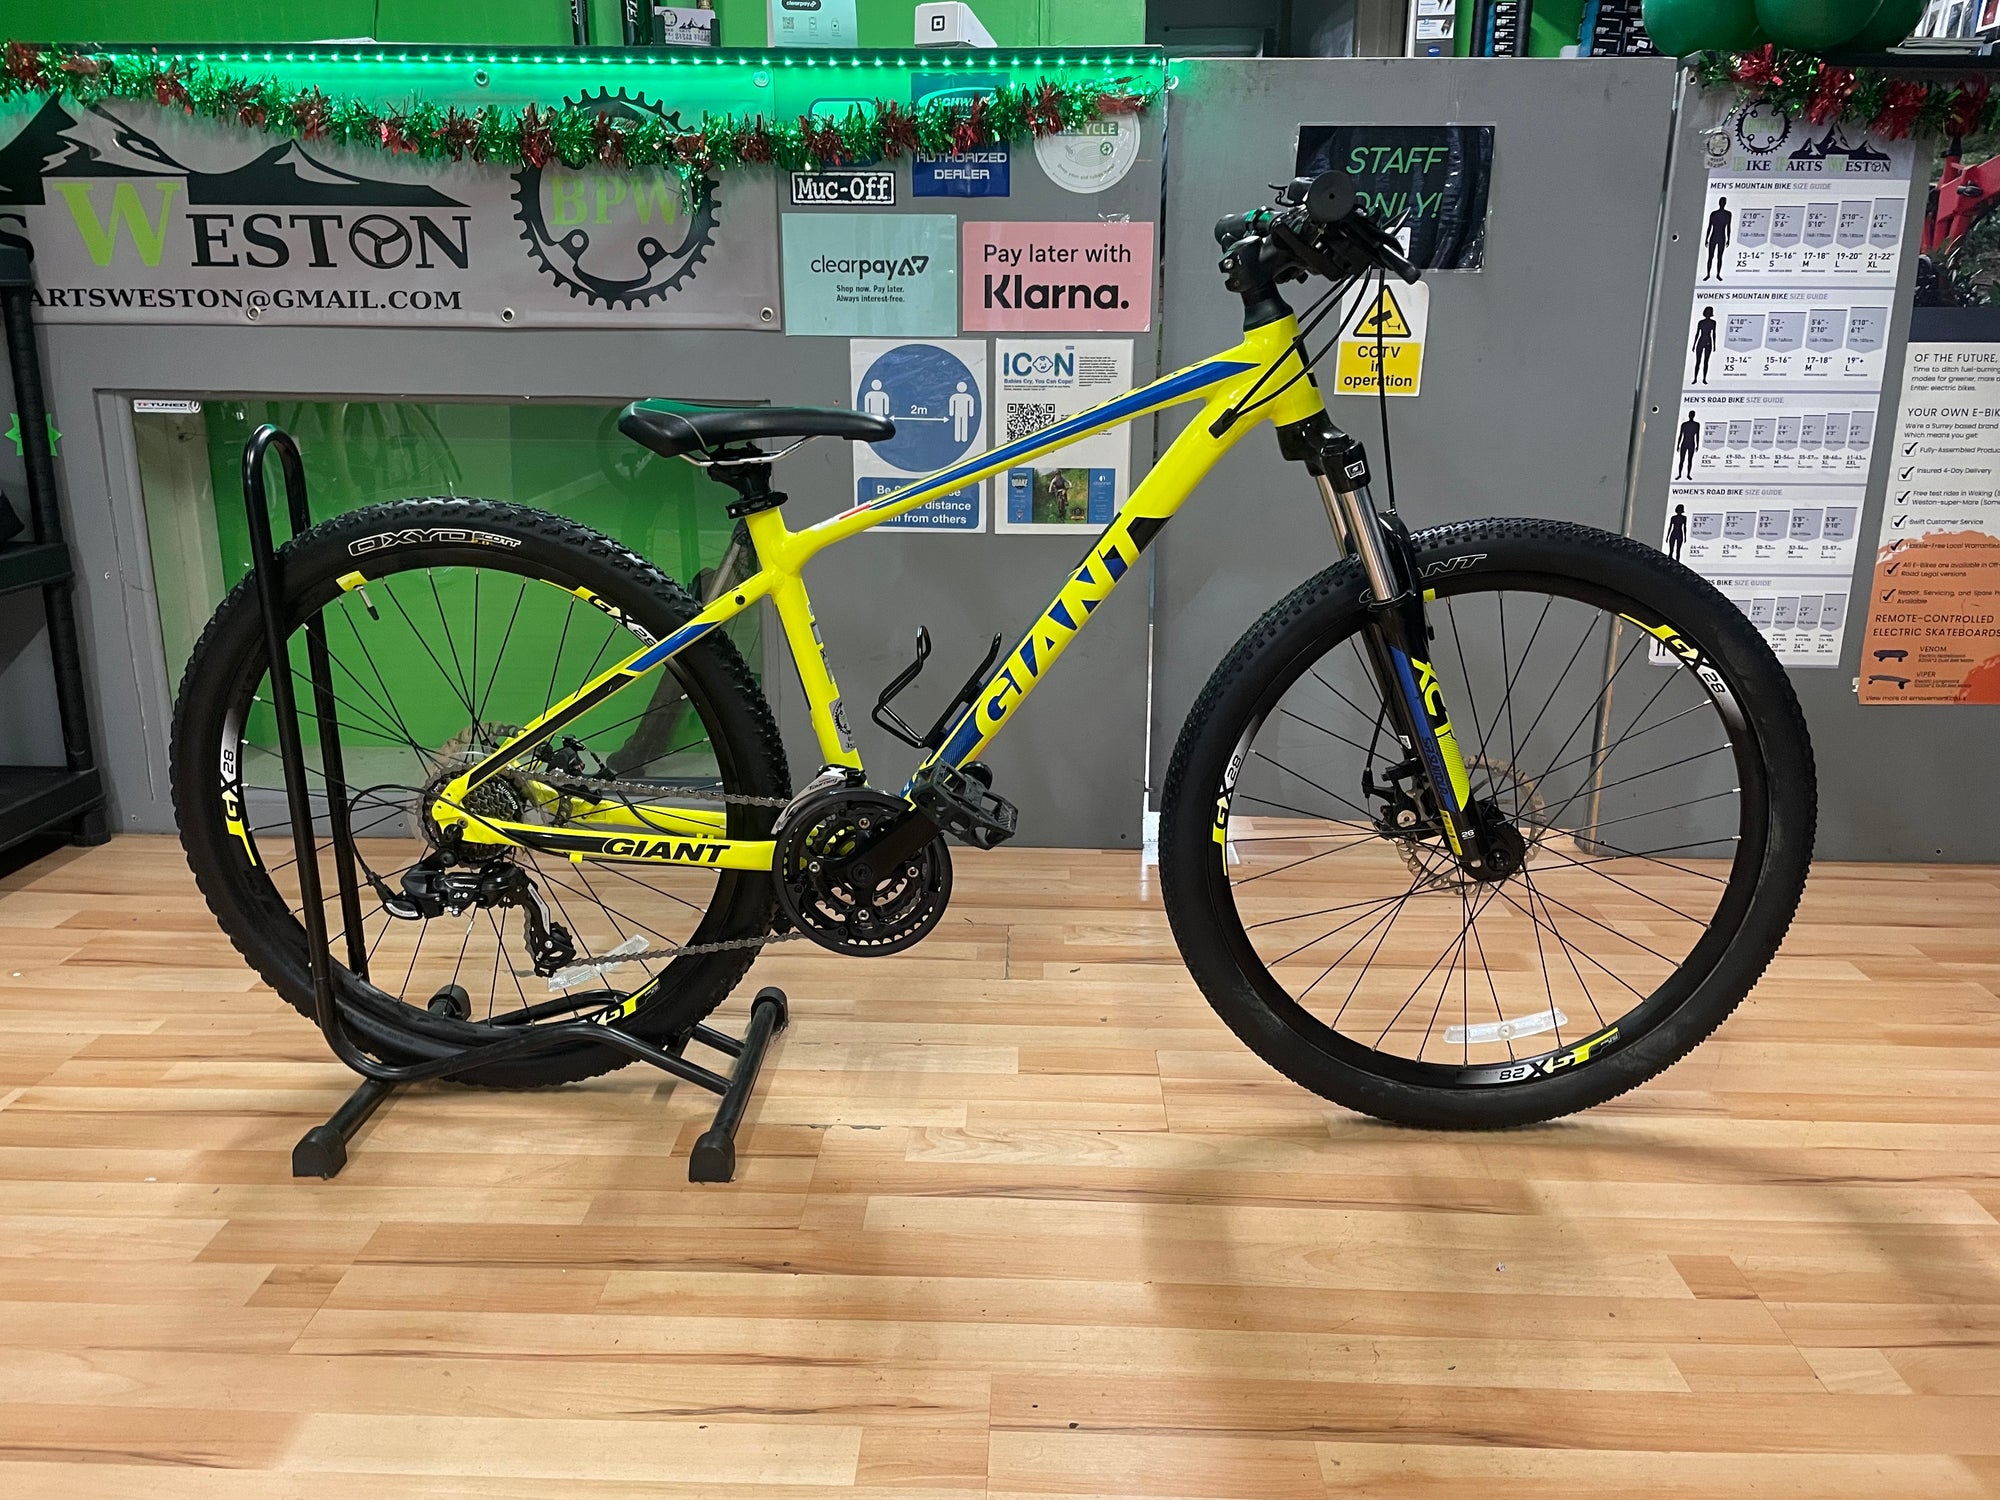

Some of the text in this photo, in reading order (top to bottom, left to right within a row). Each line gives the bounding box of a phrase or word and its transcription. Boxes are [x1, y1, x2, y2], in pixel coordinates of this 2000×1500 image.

[1346, 146, 1449, 174] STAFF
[1733, 156, 1771, 172] BIKE
[1776, 157, 1823, 172] PARTS
[934, 170, 990, 179] DEALER
[797, 176, 891, 200] Muc-Off
[550, 176, 684, 225] BPW
[52, 181, 471, 269] WESTON
[984, 243, 1131, 266] Pay later with
[811, 255, 896, 280] clearpay
[837, 285, 853, 293] Shop
[874, 285, 885, 293] Pay
[984, 274, 1130, 309] Klarna.
[1004, 353, 1073, 376] ICON
[1914, 354, 1998, 363] OF THE FUTURE,
[1344, 374, 1412, 390] opertion
[910, 405, 928, 415] 2m
[1908, 408, 1937, 416] YOUR
[1941, 408, 1969, 416] OWN
[925, 501, 971, 510] distance
[904, 514, 928, 522] from
[932, 515, 967, 524] others
[975, 514, 1141, 738] GIANT
[1875, 614, 1994, 623] REMOTE-CONTROLLED
[1873, 628, 1921, 636] ELECTRIC
[601, 837, 730, 863] GIANT
